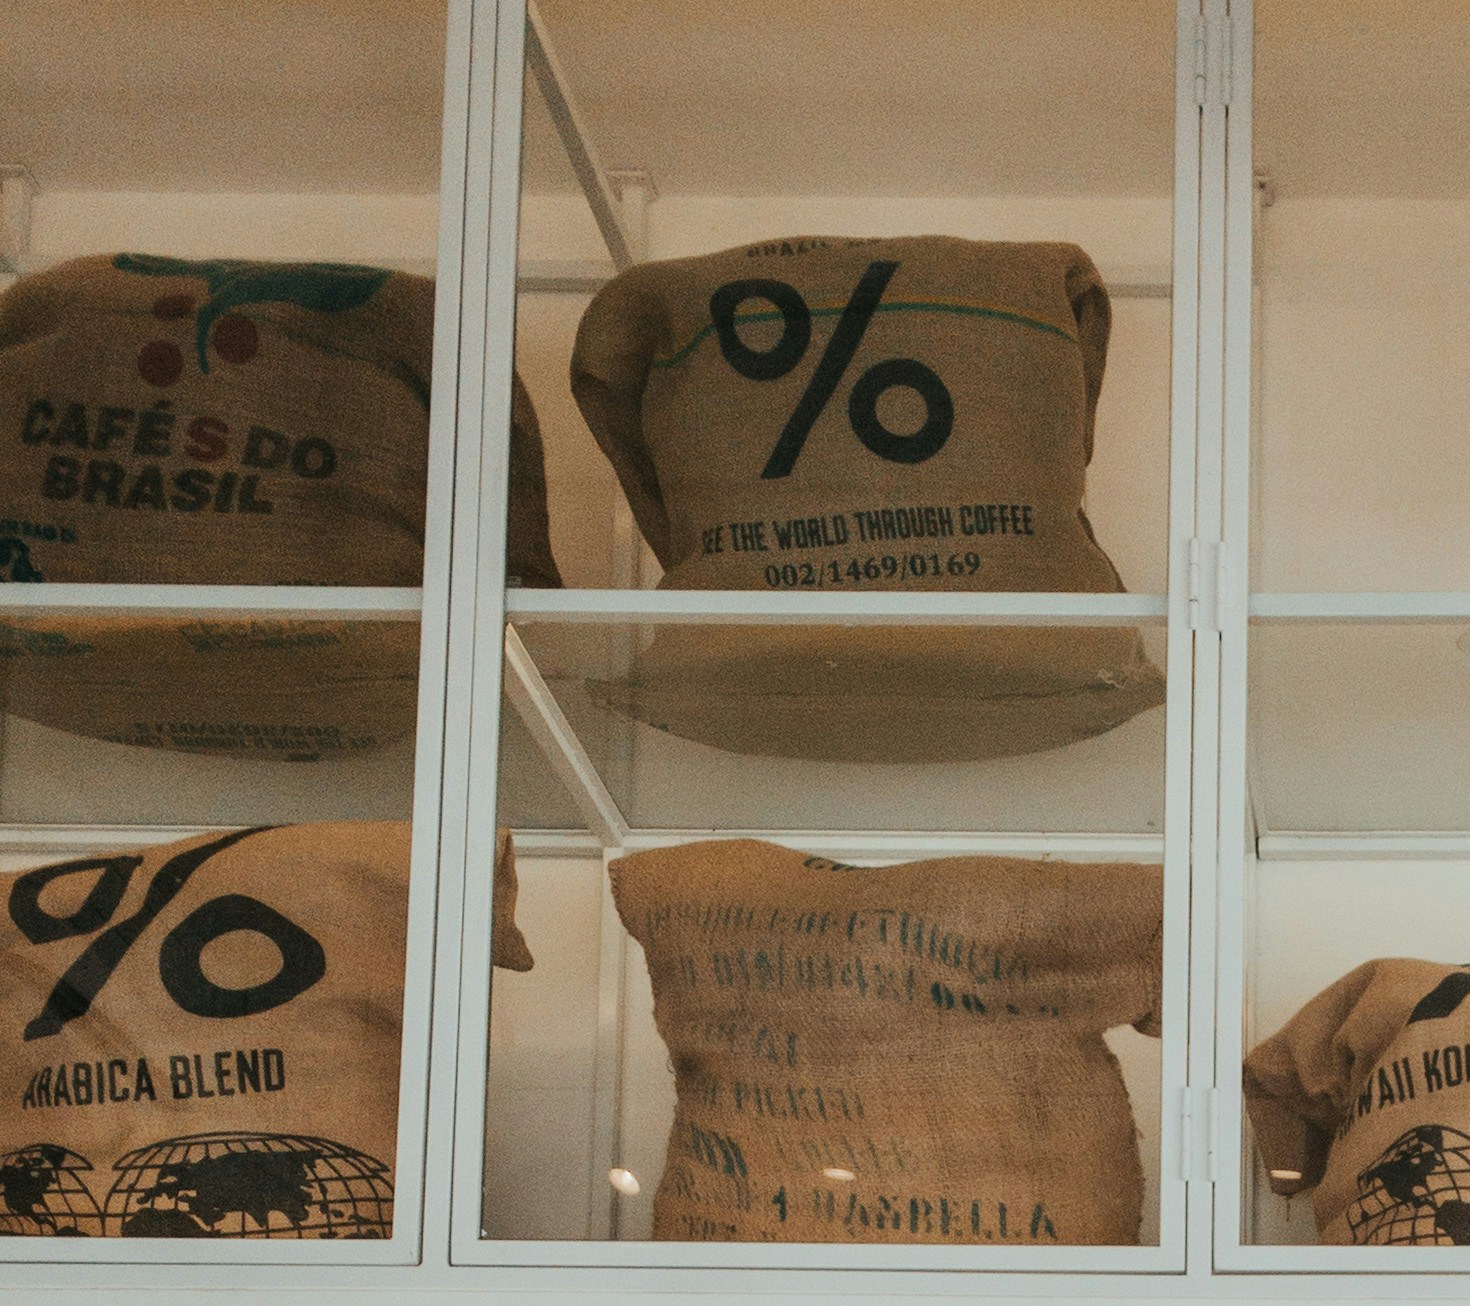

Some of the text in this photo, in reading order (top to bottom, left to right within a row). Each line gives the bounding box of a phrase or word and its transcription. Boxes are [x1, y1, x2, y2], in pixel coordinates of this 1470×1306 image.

[242, 425, 338, 479] DO
[42, 455, 275, 514] BRASIL
[731, 521, 768, 552] THE
[774, 514, 849, 550] WORLD
[854, 507, 955, 541] THROUGH
[960, 504, 1034, 537] COFFEE
[765, 552, 981, 588] 002/1469/0169
[22, 1048, 286, 1111] ARABICA BLEND
